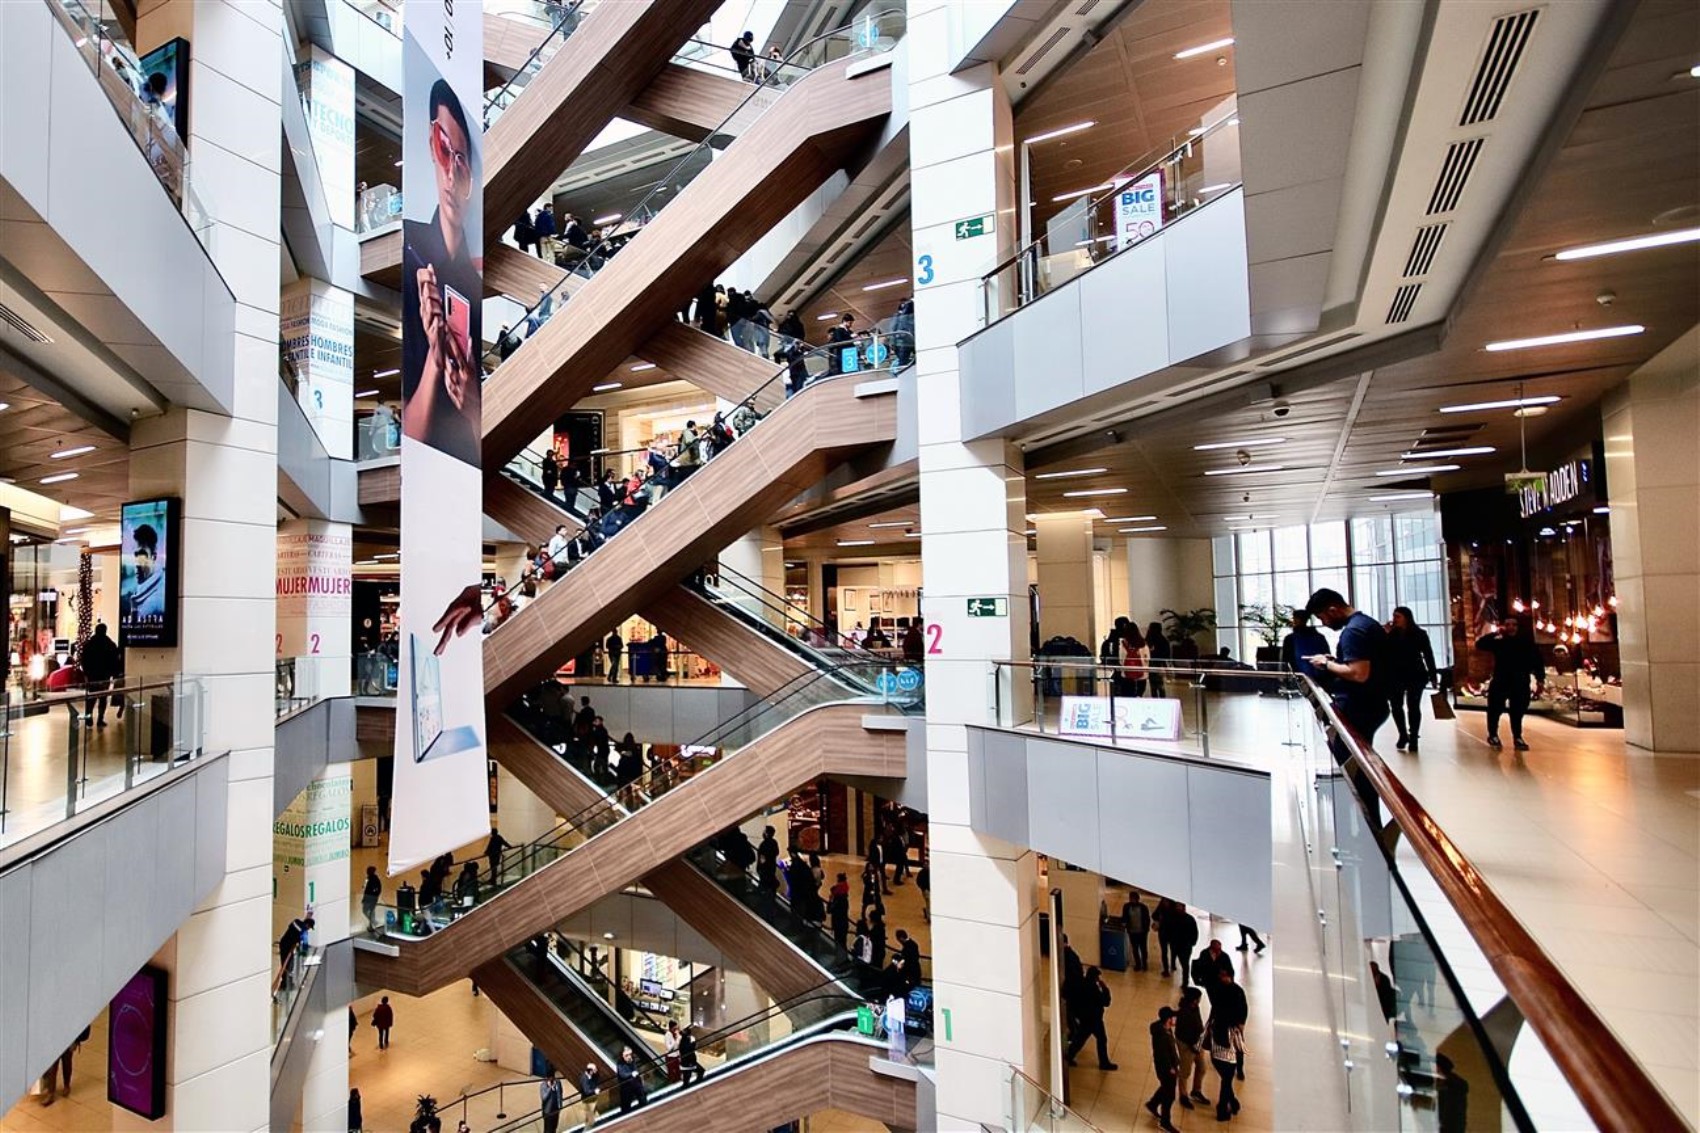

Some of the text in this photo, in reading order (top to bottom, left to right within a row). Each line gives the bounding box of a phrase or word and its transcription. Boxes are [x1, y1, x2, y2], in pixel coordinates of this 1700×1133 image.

[313, 100, 353, 135] TECNO
[1122, 190, 1155, 206] BIG
[1122, 203, 1156, 216] SALE
[917, 254, 934, 285] 3
[311, 335, 353, 358] HOMBRES
[310, 350, 353, 370] E INFANTIL
[313, 389, 324, 410] 3
[308, 577, 351, 594] MUJER
[311, 633, 320, 653] 2
[927, 623, 943, 655] 2
[1076, 703, 1091, 729] BIG
[305, 817, 349, 838] REGALOS
[308, 881, 315, 903] 1
[941, 1007, 952, 1042] 1
